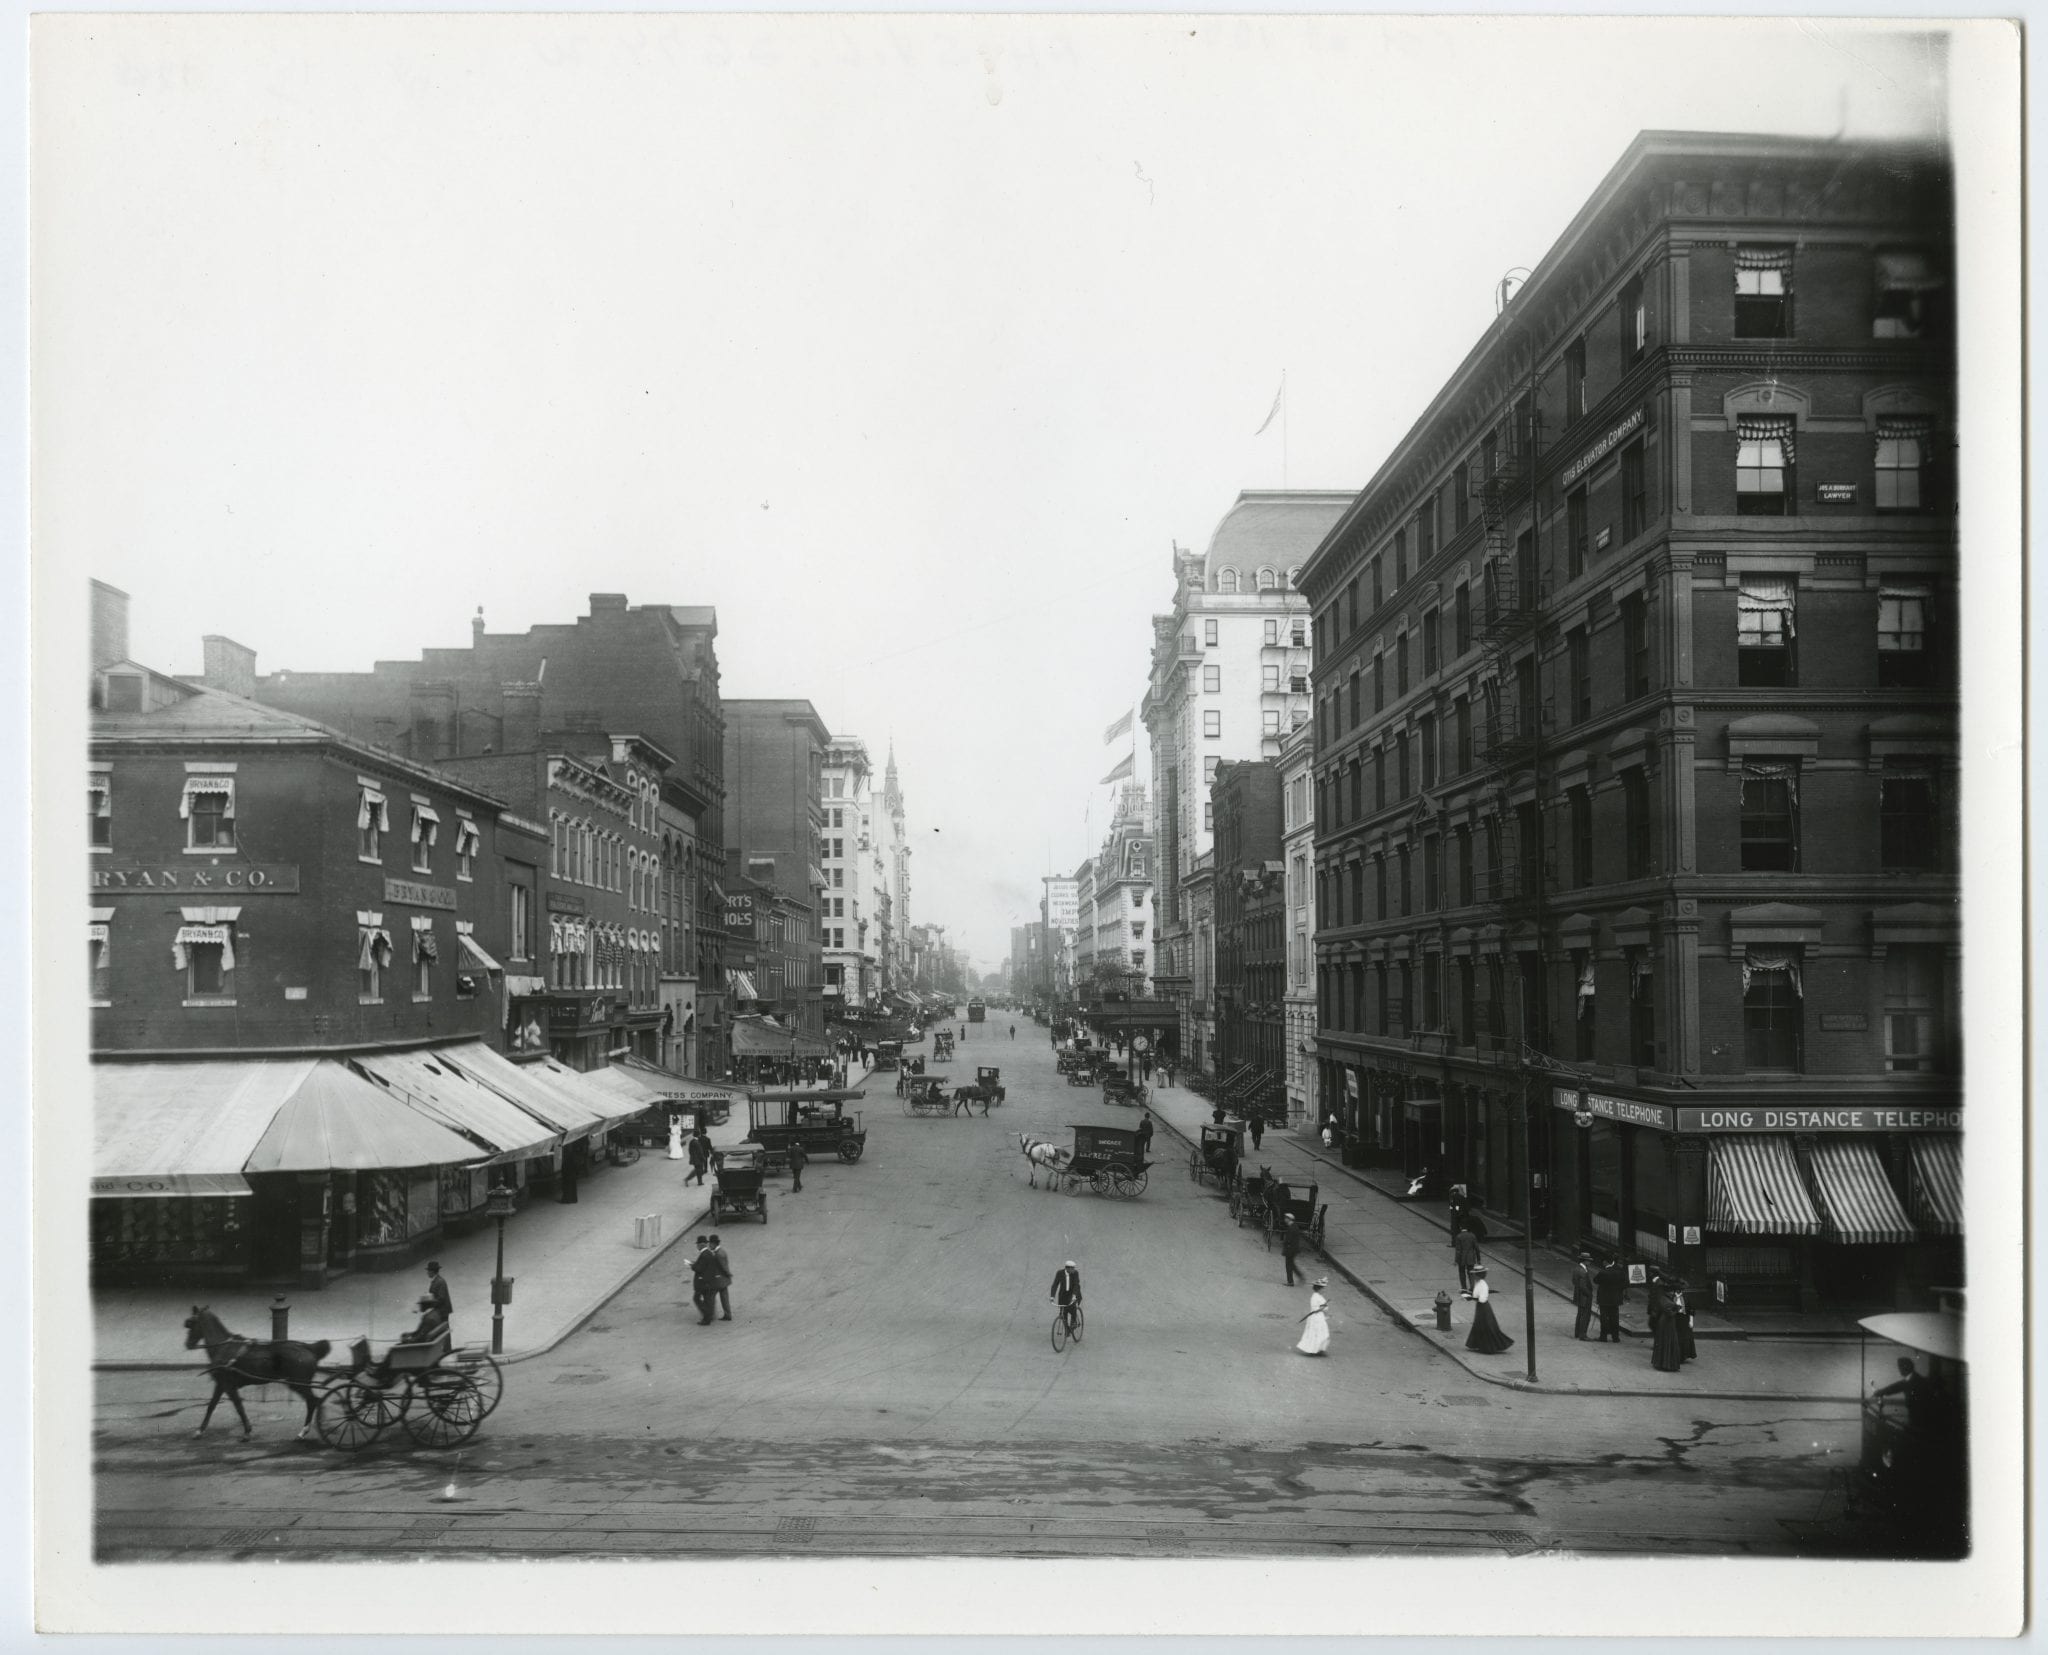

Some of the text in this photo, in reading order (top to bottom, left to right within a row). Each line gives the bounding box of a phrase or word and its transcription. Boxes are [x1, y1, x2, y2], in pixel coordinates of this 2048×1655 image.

[1562, 408, 1642, 485] OTIS ELEVATOR COMPANY
[192, 870, 213, 887] &
[225, 870, 274, 887] CO.
[1560, 1092, 1578, 1108] LONG
[1701, 1111, 1754, 1128] LONG
[1765, 1111, 1863, 1128] DISTANCE
